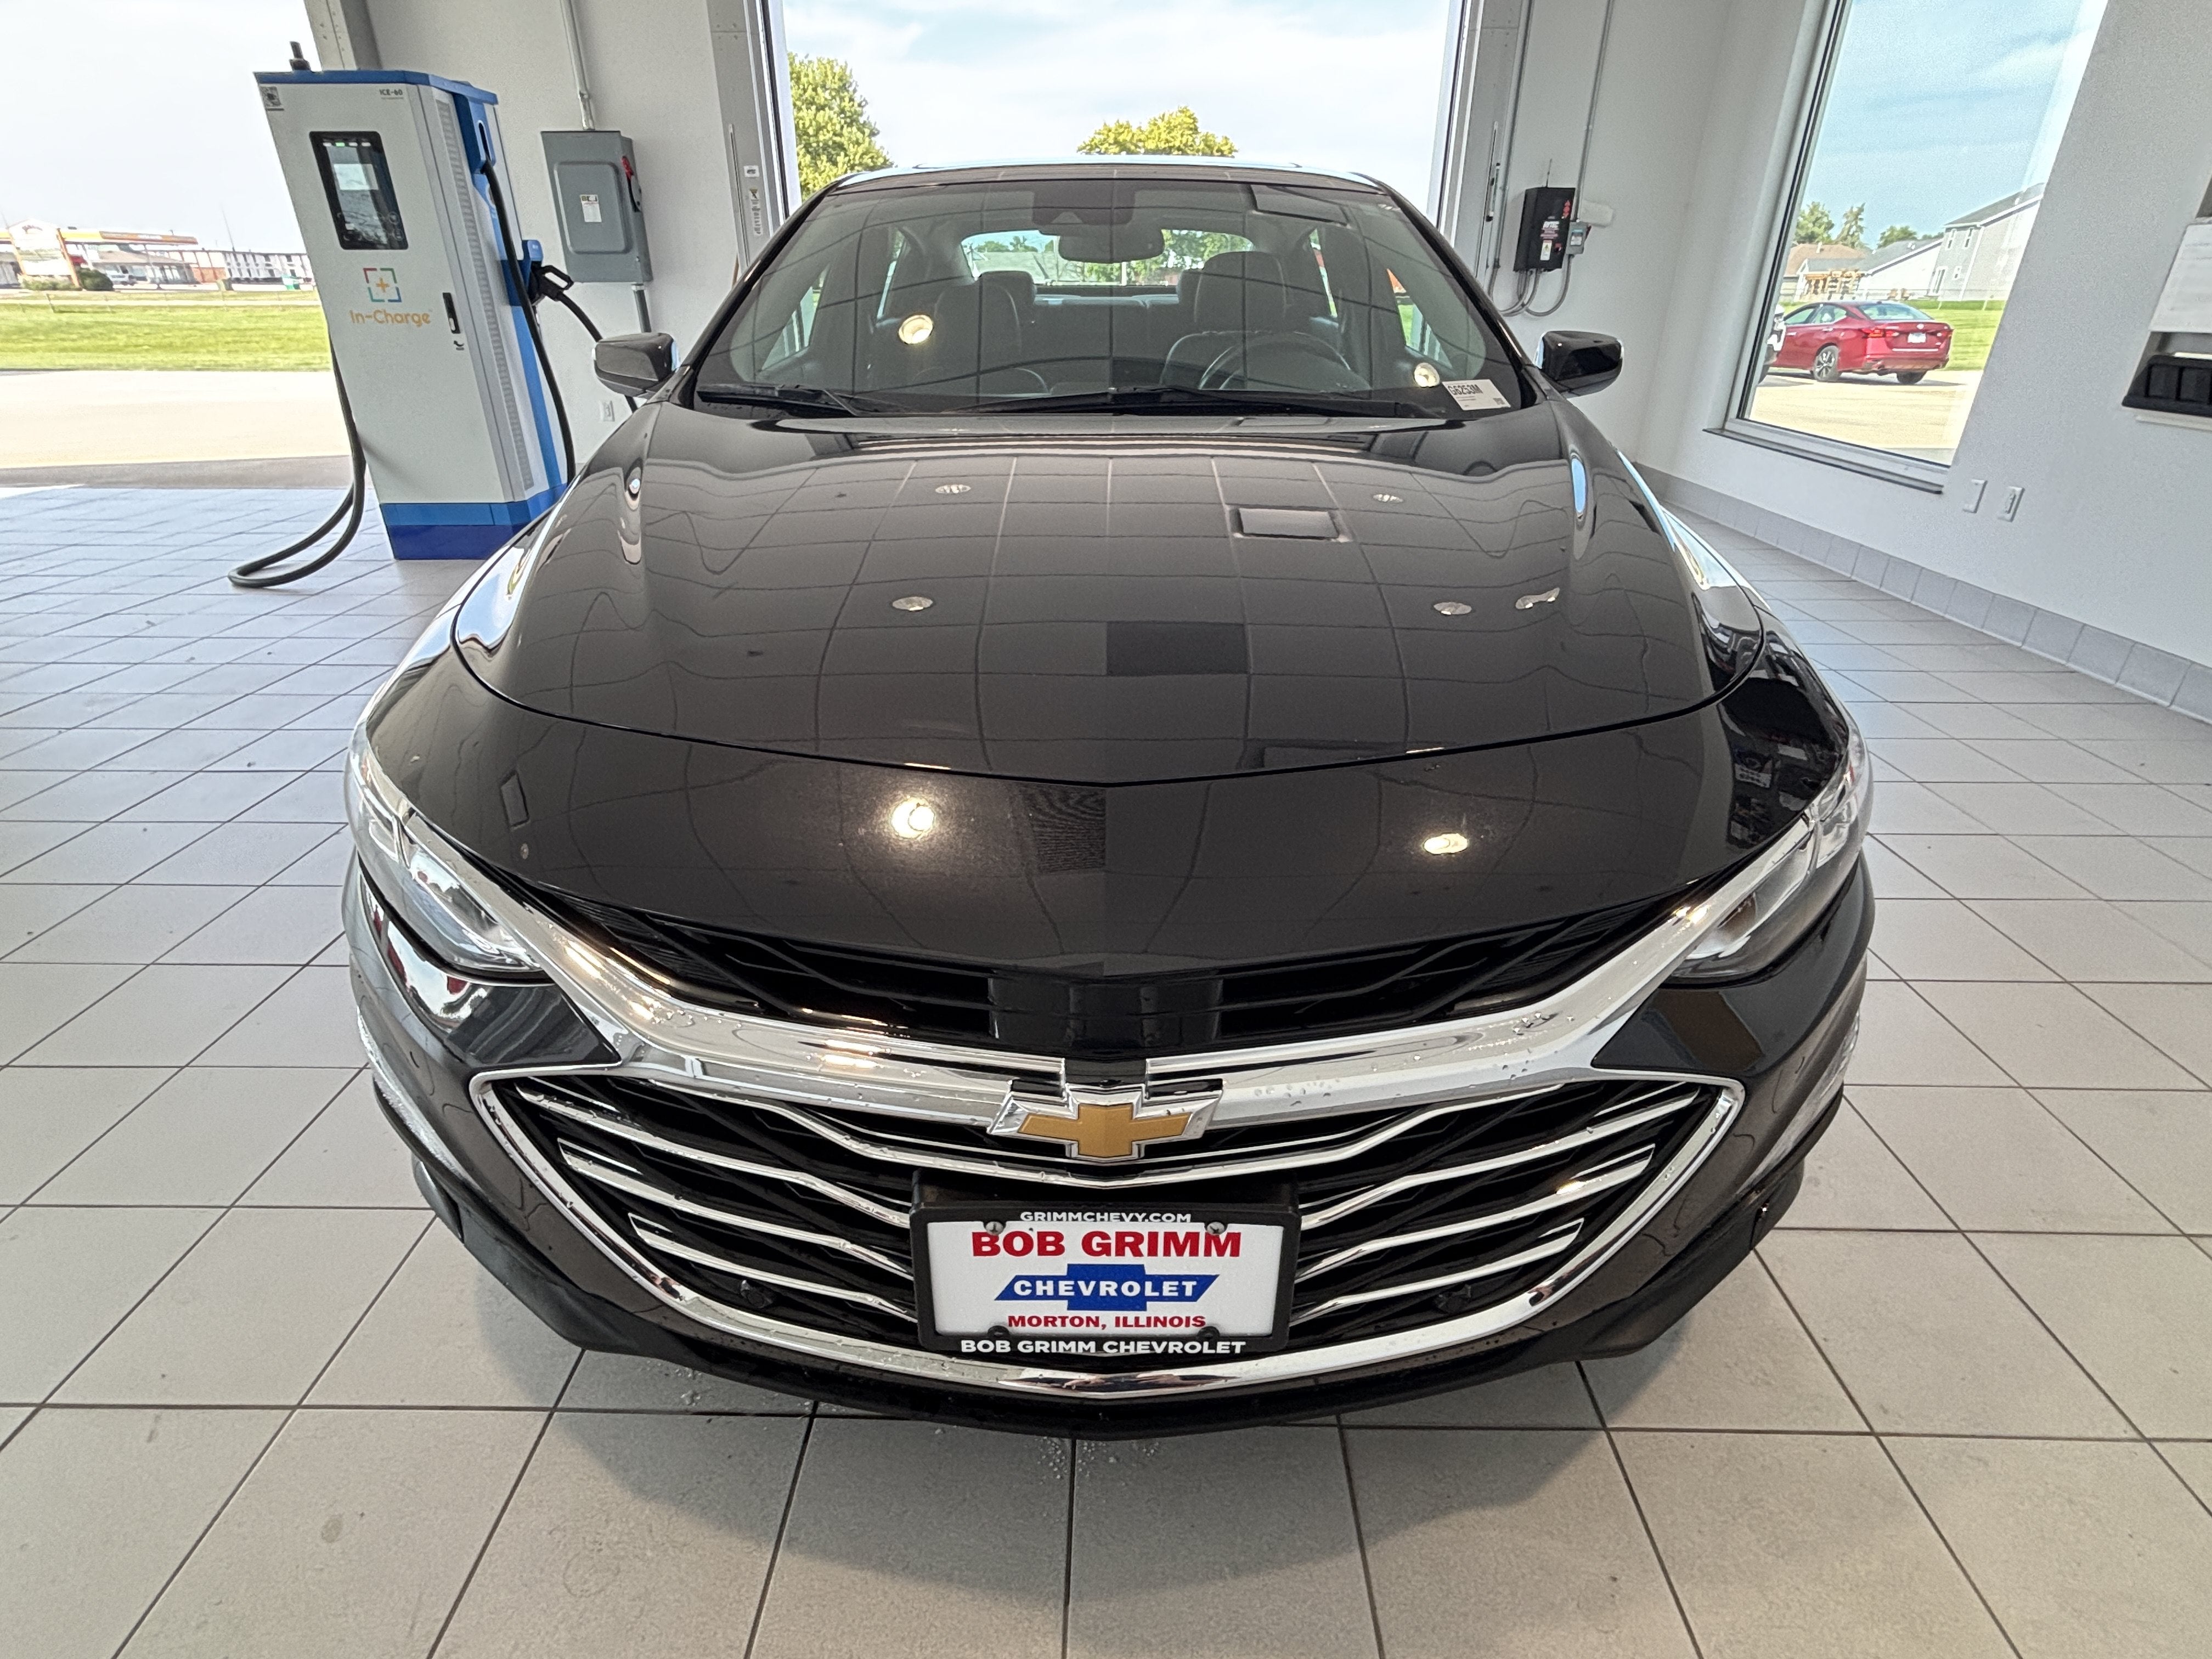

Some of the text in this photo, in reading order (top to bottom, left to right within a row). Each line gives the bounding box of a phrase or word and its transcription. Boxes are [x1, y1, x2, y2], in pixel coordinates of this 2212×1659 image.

[349, 309, 431, 327] In-Charge
[1020, 1211, 1192, 1223] GRIMMCHEVY.COM
[972, 1231, 1242, 1257] BOB GRIMM
[1013, 1280, 1198, 1297] CHEVROLET
[1008, 1315, 1206, 1330] MORTON, ILLINOIS
[961, 1339, 1246, 1355] BOB GRIMM CHEVROLET
